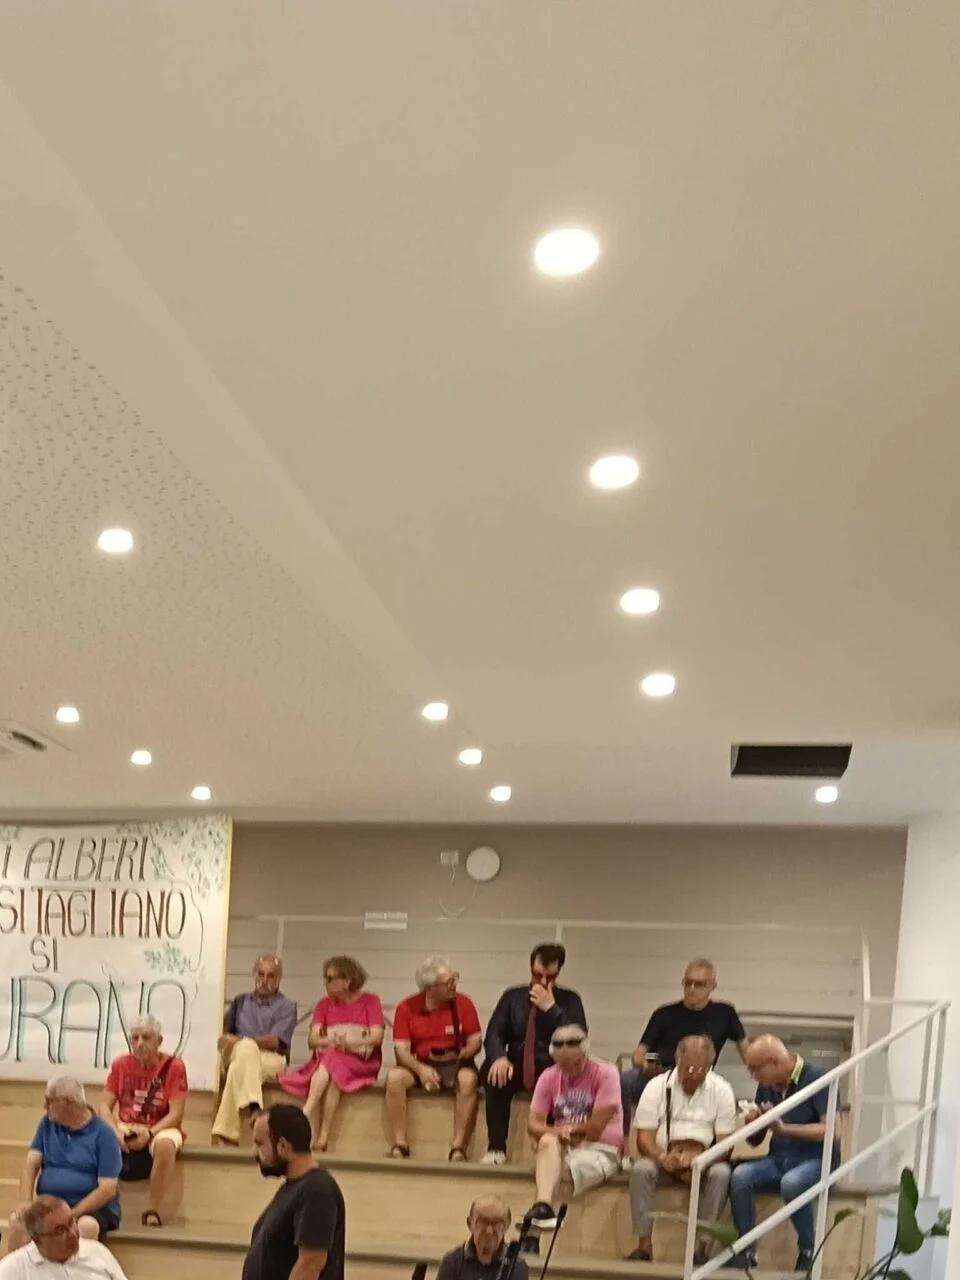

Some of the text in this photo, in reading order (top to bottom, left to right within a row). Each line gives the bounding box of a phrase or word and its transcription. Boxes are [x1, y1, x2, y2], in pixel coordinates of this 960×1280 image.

[24, 836, 148, 881] ALBERI
[30, 886, 187, 939] TAGLIANO
[30, 937, 59, 973] SI
